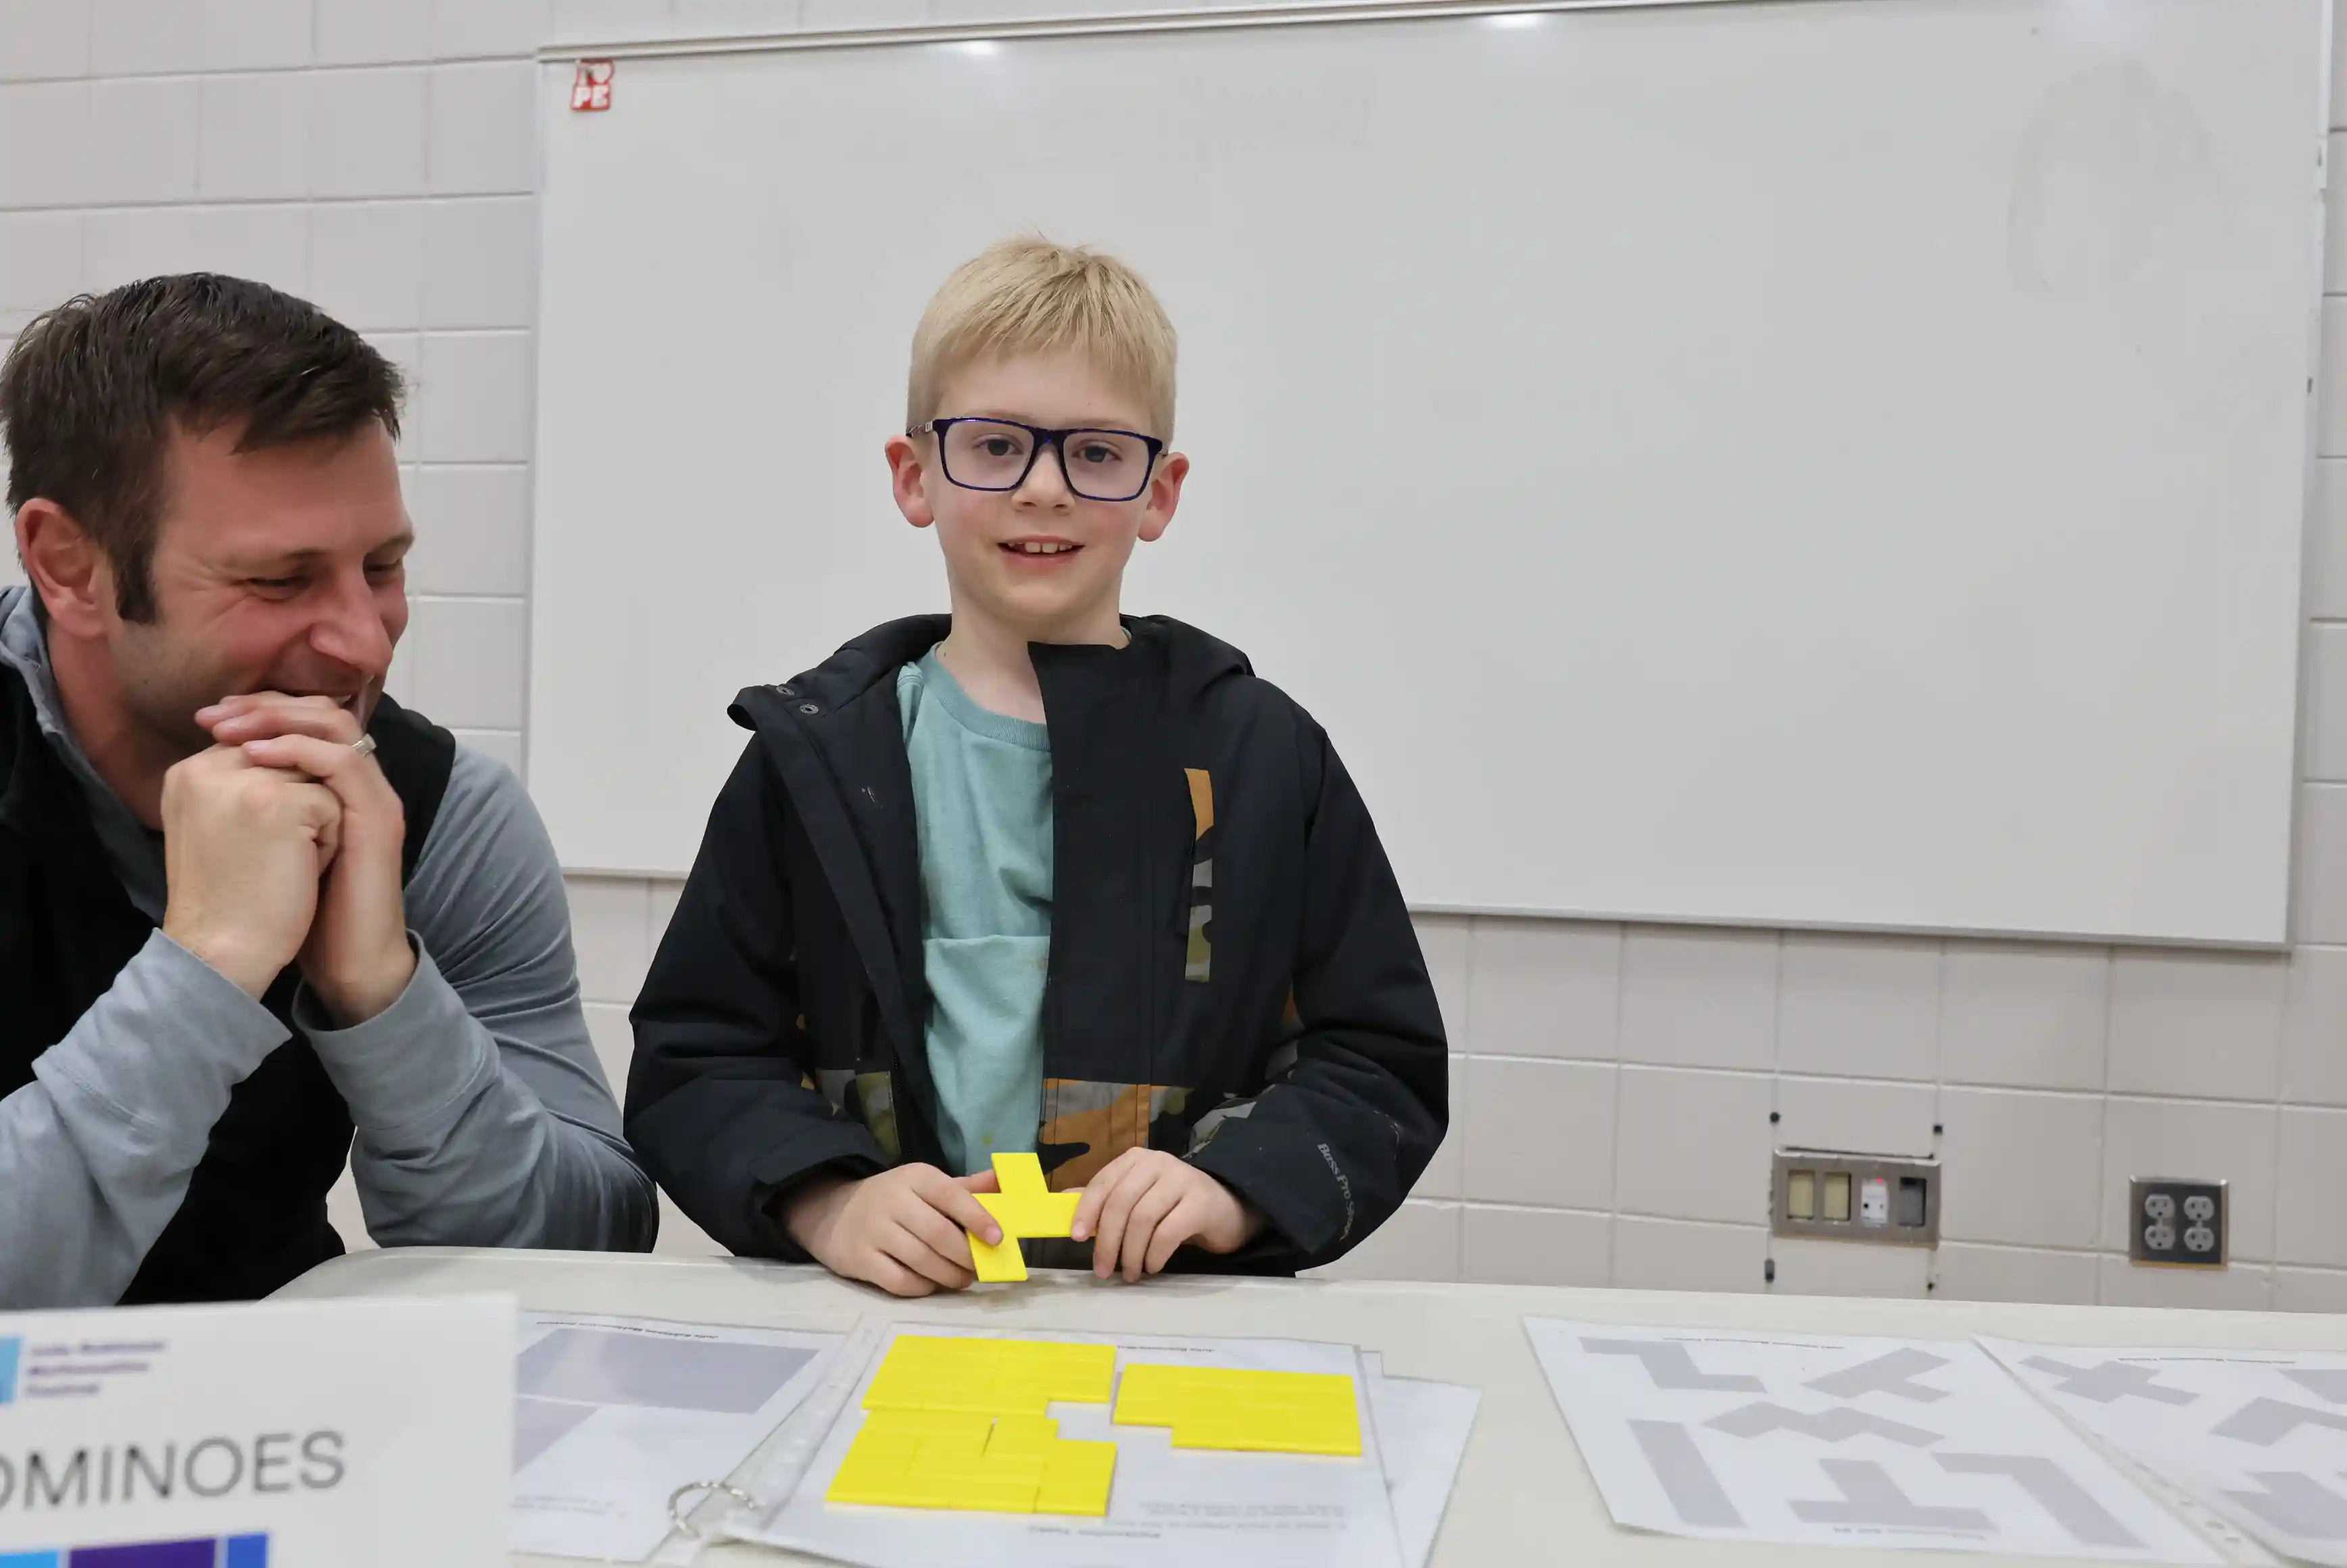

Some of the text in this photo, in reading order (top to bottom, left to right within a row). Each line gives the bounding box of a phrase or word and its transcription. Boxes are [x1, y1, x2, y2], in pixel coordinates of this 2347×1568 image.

[1317, 1143, 1340, 1175] Bass
[1336, 1175, 1351, 1200] Pro
[0, 1429, 347, 1510] MINOES
